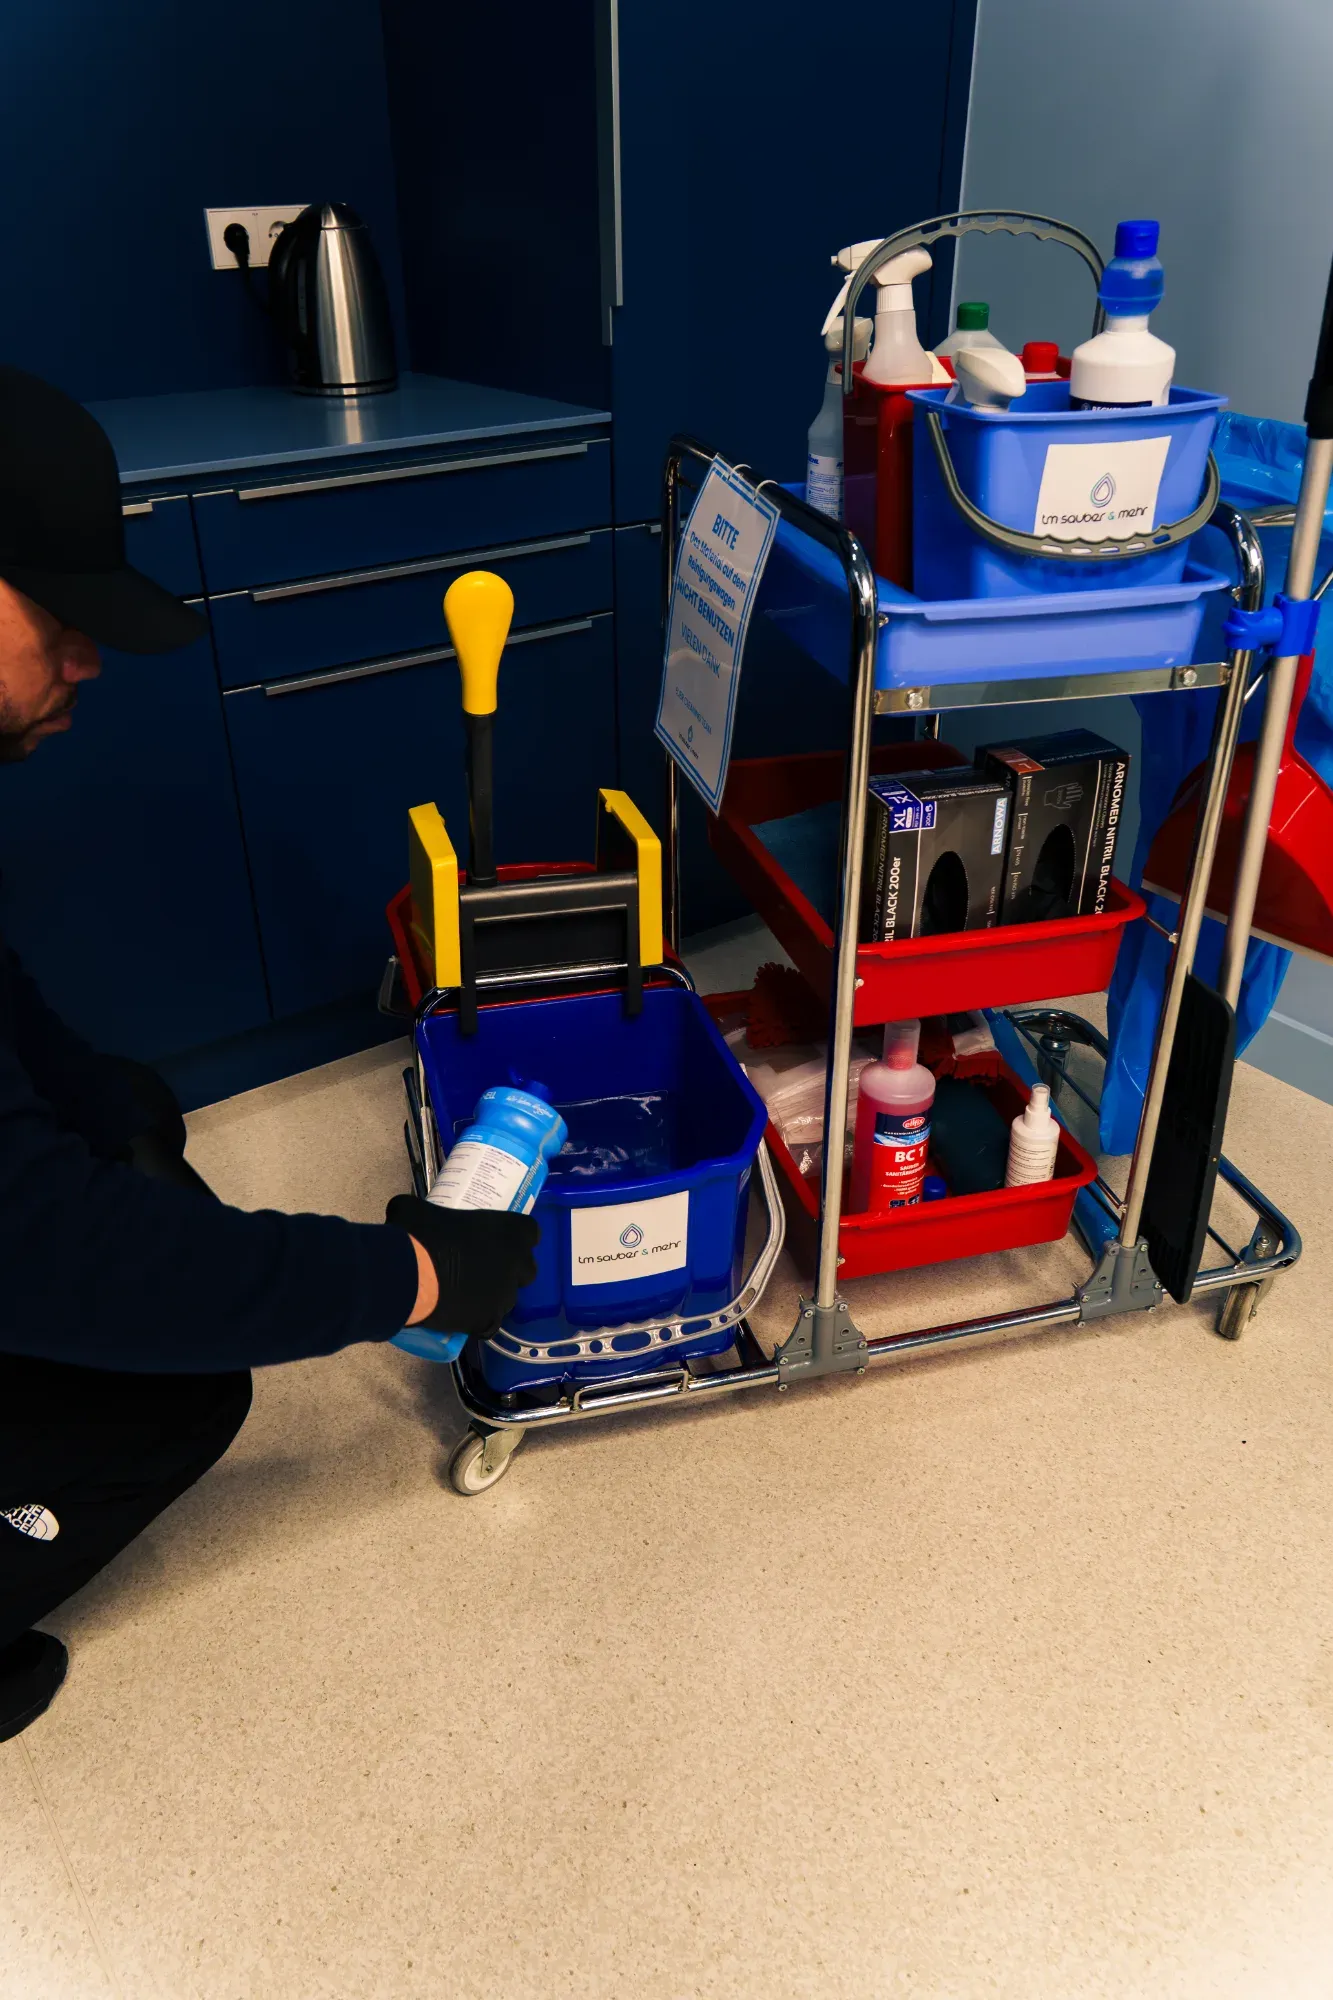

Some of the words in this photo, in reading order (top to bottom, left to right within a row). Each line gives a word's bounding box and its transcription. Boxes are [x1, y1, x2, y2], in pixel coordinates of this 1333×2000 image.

[712, 513, 740, 550] BITTE
[1060, 512, 1106, 524] sauber
[1107, 511, 1115, 520] &
[1117, 506, 1148, 519] mehr
[688, 554, 736, 611] Reinigungswagen
[700, 541, 724, 571] Material
[722, 564, 735, 580] auf
[732, 573, 747, 594] dem
[677, 575, 699, 609] NICHT
[697, 597, 736, 648] BENUTZEN
[680, 621, 702, 656] VIELEN
[701, 645, 721, 678] DANK
[1108, 762, 1126, 824] ARNOMED
[879, 807, 888, 866] ARNOMED
[893, 808, 907, 829] XL
[993, 797, 1007, 854] ARNOWA
[1103, 826, 1116, 864] NITRIL
[876, 865, 885, 893] NITRIL
[888, 856, 901, 890] 200er
[1096, 864, 1110, 904] BLACK
[873, 894, 882, 926] BLACK
[885, 891, 898, 928] BLACK
[894, 1149, 916, 1163] BC
[597, 1250, 640, 1263] sauber
[641, 1248, 649, 1256] &
[651, 1240, 682, 1254] mehr
